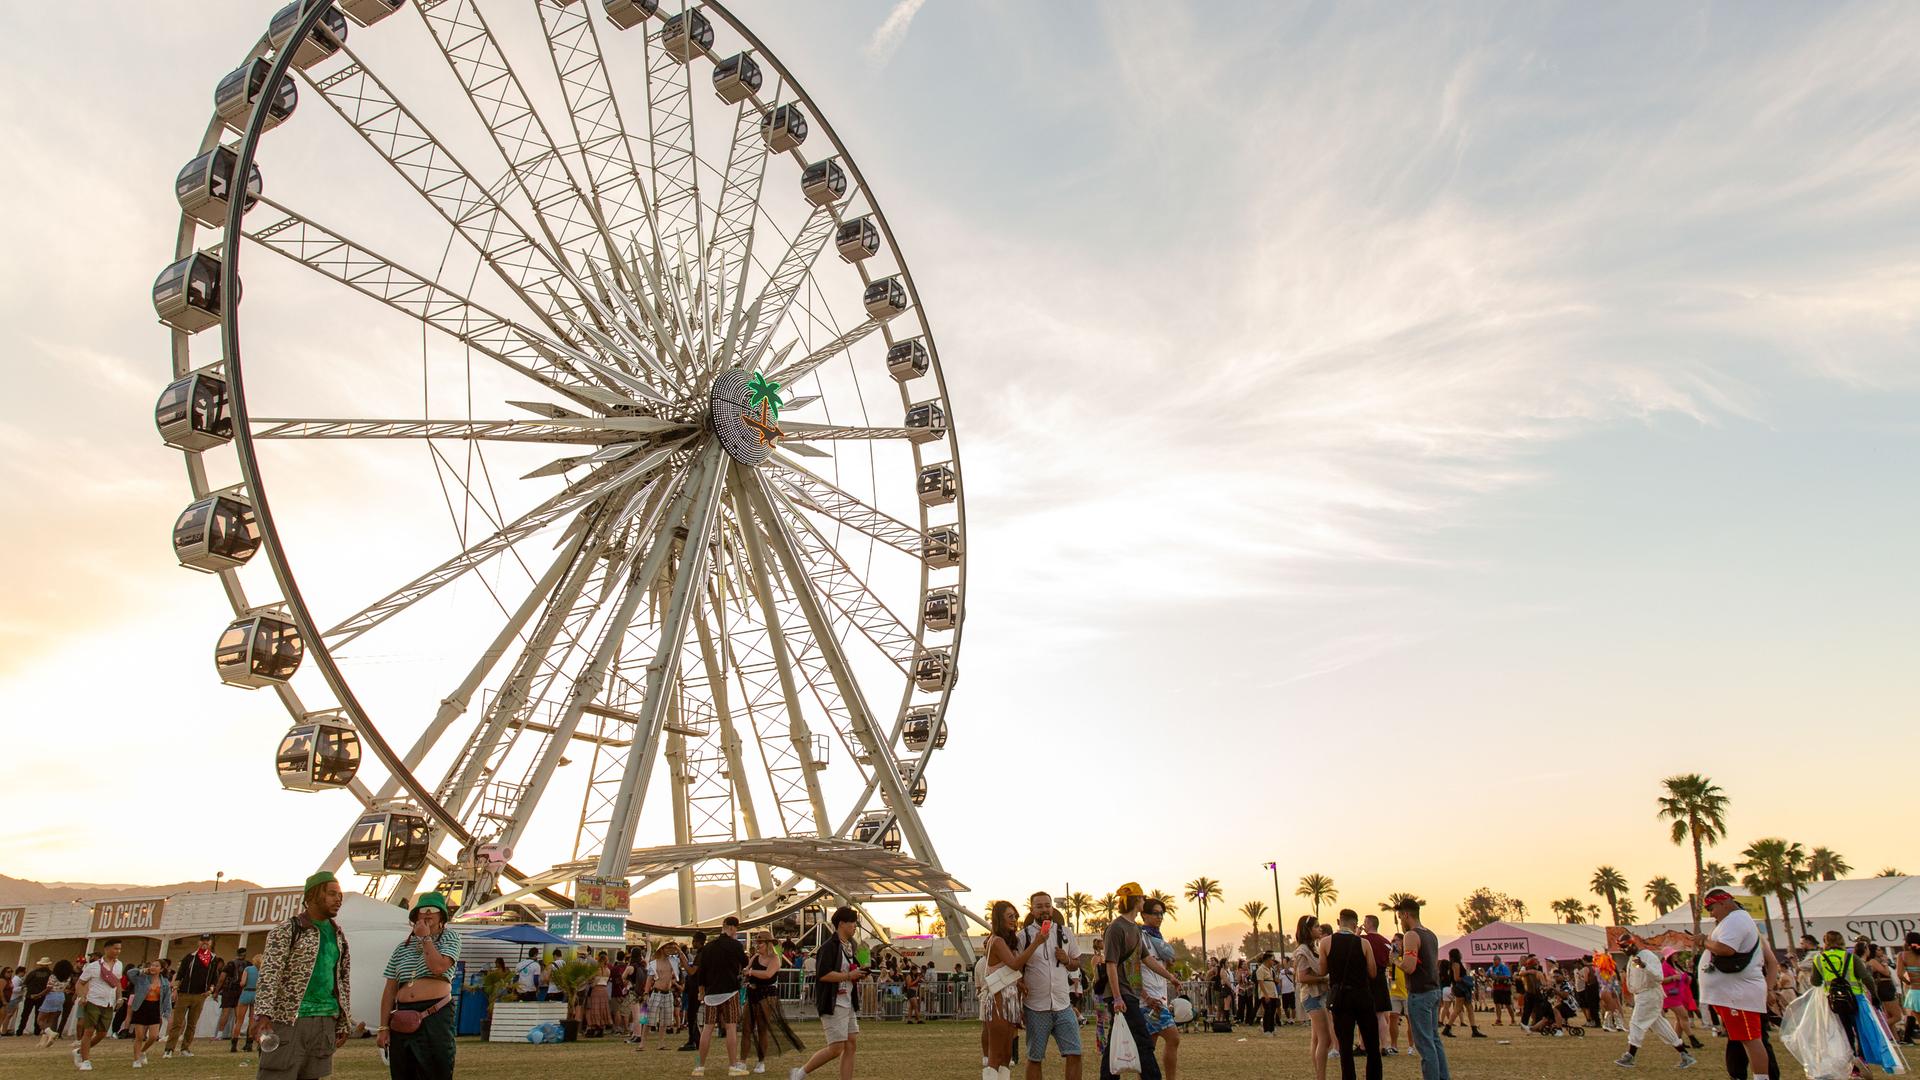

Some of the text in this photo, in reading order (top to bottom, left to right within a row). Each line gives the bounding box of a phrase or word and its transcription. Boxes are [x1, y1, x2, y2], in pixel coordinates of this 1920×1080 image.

[99, 903, 156, 929] ID CHECK
[252, 894, 305, 922] ID CHE
[586, 920, 616, 932] tickets
[1846, 919, 1920, 942] STOR
[1475, 942, 1525, 951] BLACKPINK
